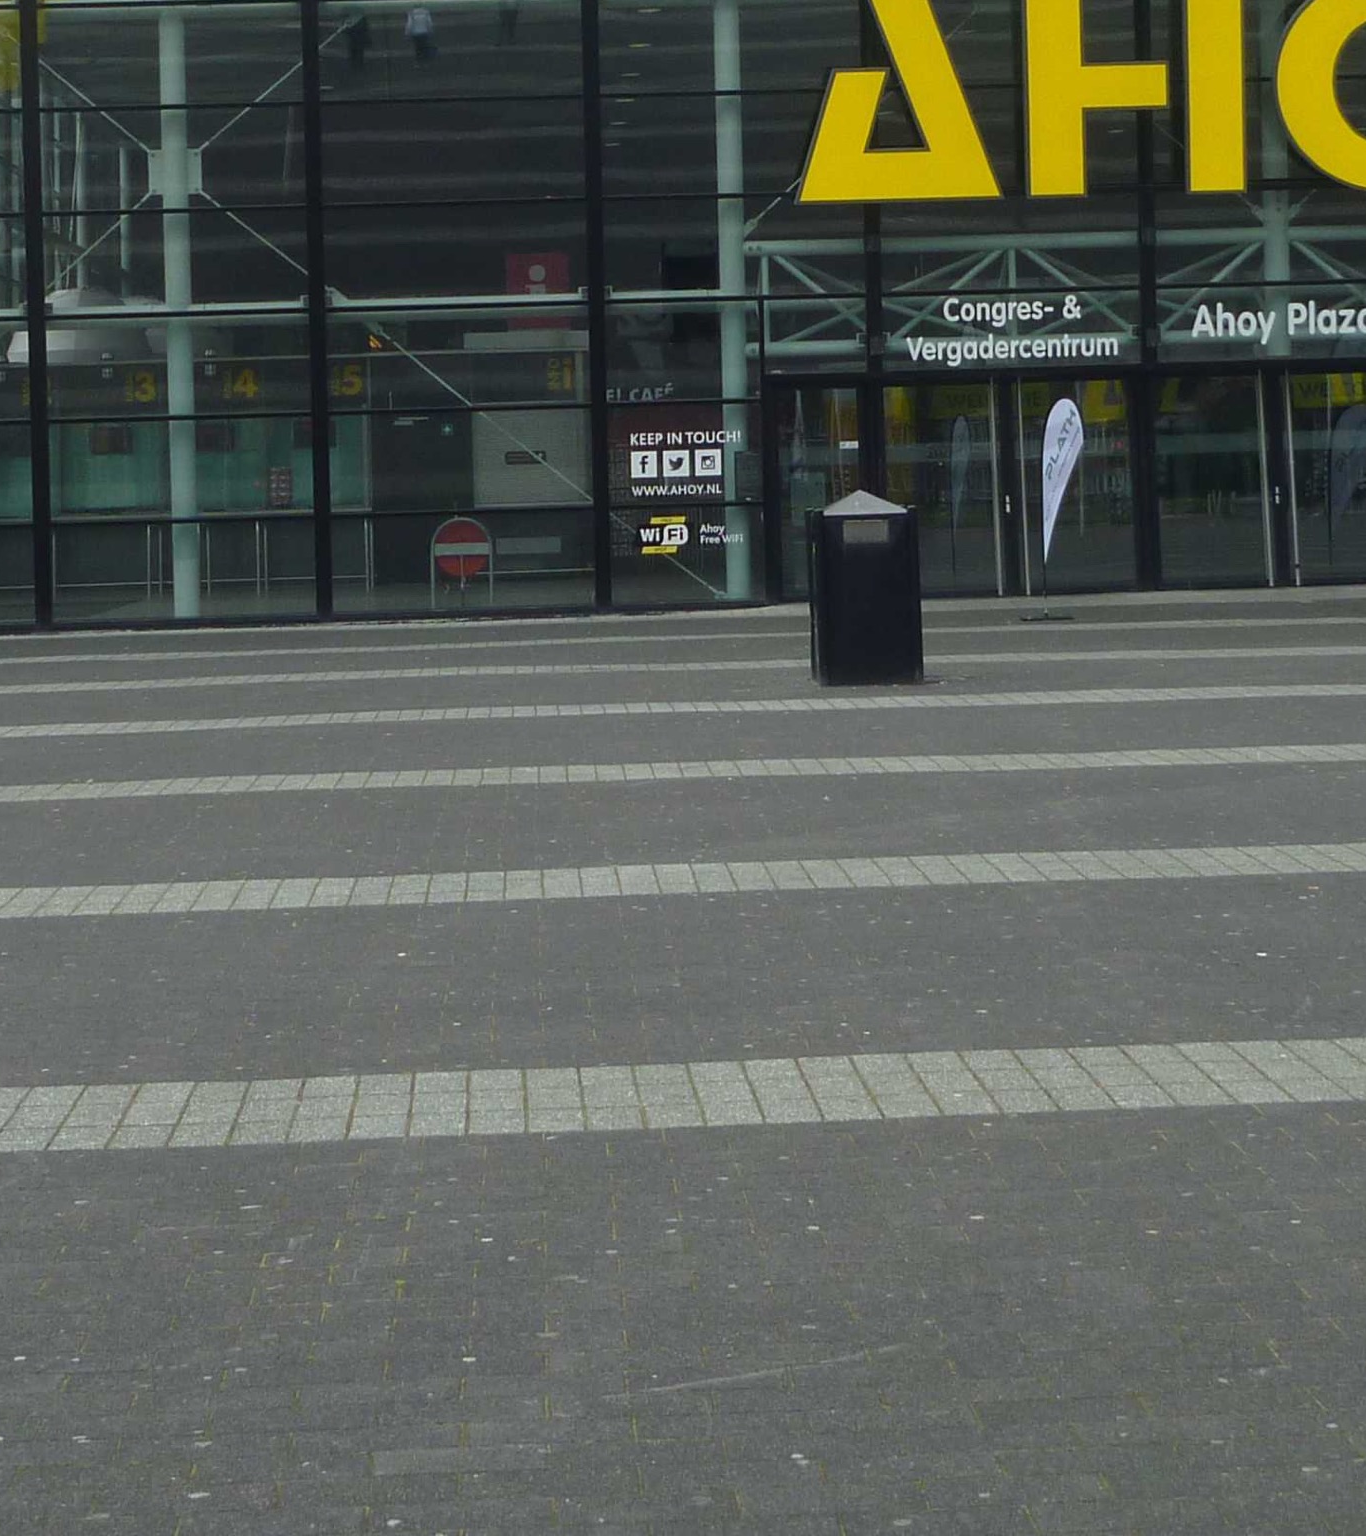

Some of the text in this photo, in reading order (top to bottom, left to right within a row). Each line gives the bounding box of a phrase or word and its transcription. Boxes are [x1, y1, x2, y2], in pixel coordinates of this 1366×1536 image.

[943, 295, 1082, 325] Congres- &
[1191, 303, 1276, 345] Ahoy
[906, 335, 1119, 366] Vergadercentrum
[630, 430, 742, 446] KEEP IN TOUCH!
[1046, 408, 1077, 480] PLATH
[632, 484, 722, 496] WWW.AHOY.NL
[700, 524, 725, 536] Ahoy
[700, 535, 721, 544] Free
